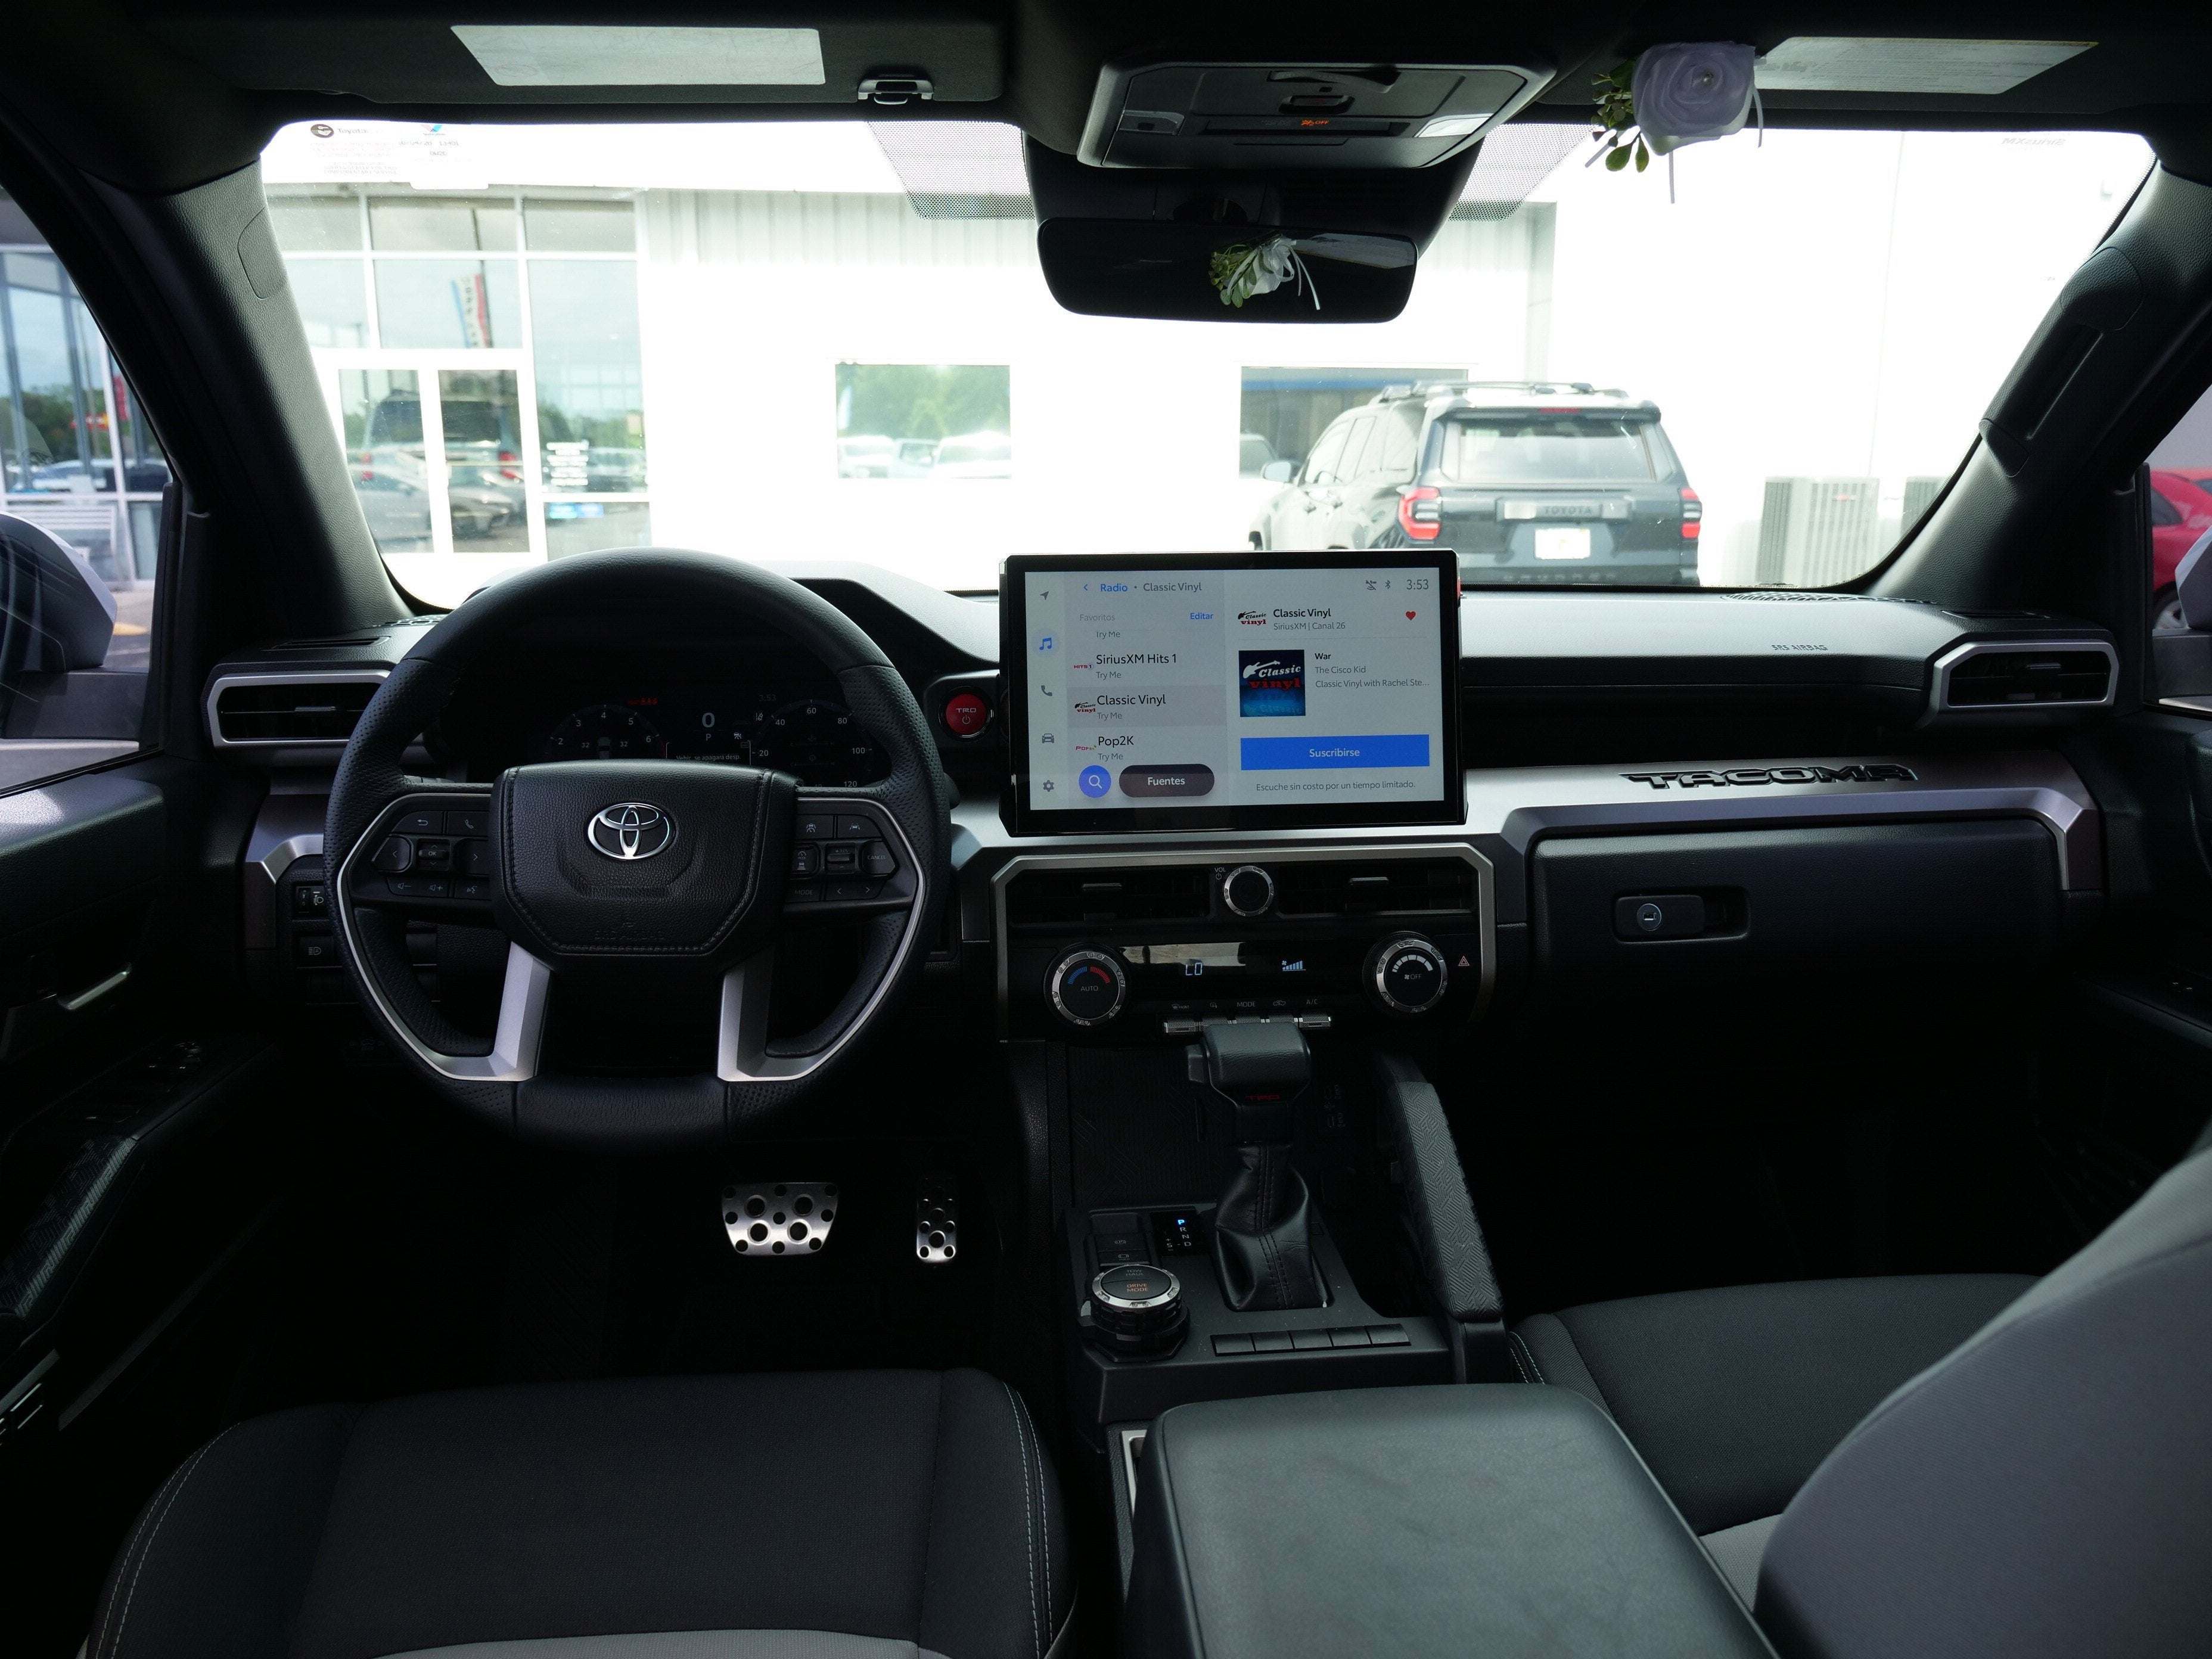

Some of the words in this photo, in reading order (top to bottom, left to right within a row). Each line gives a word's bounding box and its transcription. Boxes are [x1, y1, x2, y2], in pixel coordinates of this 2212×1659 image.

[1543, 505, 1593, 515] TOYOTA
[1100, 583, 1128, 592] Radio
[1143, 583, 1176, 591] Classic
[1178, 582, 1202, 593] Vinyl
[1406, 579, 1429, 590] 3:53
[1273, 609, 1306, 618] Classic
[1307, 608, 1331, 619] Vinyl
[1096, 654, 1144, 664] SiriusXM
[1148, 654, 1169, 663] Hits
[1172, 654, 1176, 663] 1
[1096, 672, 1107, 680] Try
[1259, 664, 1301, 678] Classic
[1248, 678, 1301, 691] vinyl
[1315, 680, 1342, 688] Classic
[1343, 679, 1362, 689] Vinyl
[1097, 695, 1136, 705] Classic
[1138, 694, 1166, 707] Vinyl
[702, 712, 715, 728] 0
[1098, 713, 1109, 721] Try
[1098, 735, 1134, 748] Pop2K
[1098, 753, 1110, 762] Try
[1309, 748, 1360, 758] Suscribirse
[1148, 777, 1185, 786] Fuentes
[1618, 764, 1918, 790] TACOMA
[1325, 783, 1339, 791] por
[1353, 781, 1380, 791] tiempo
